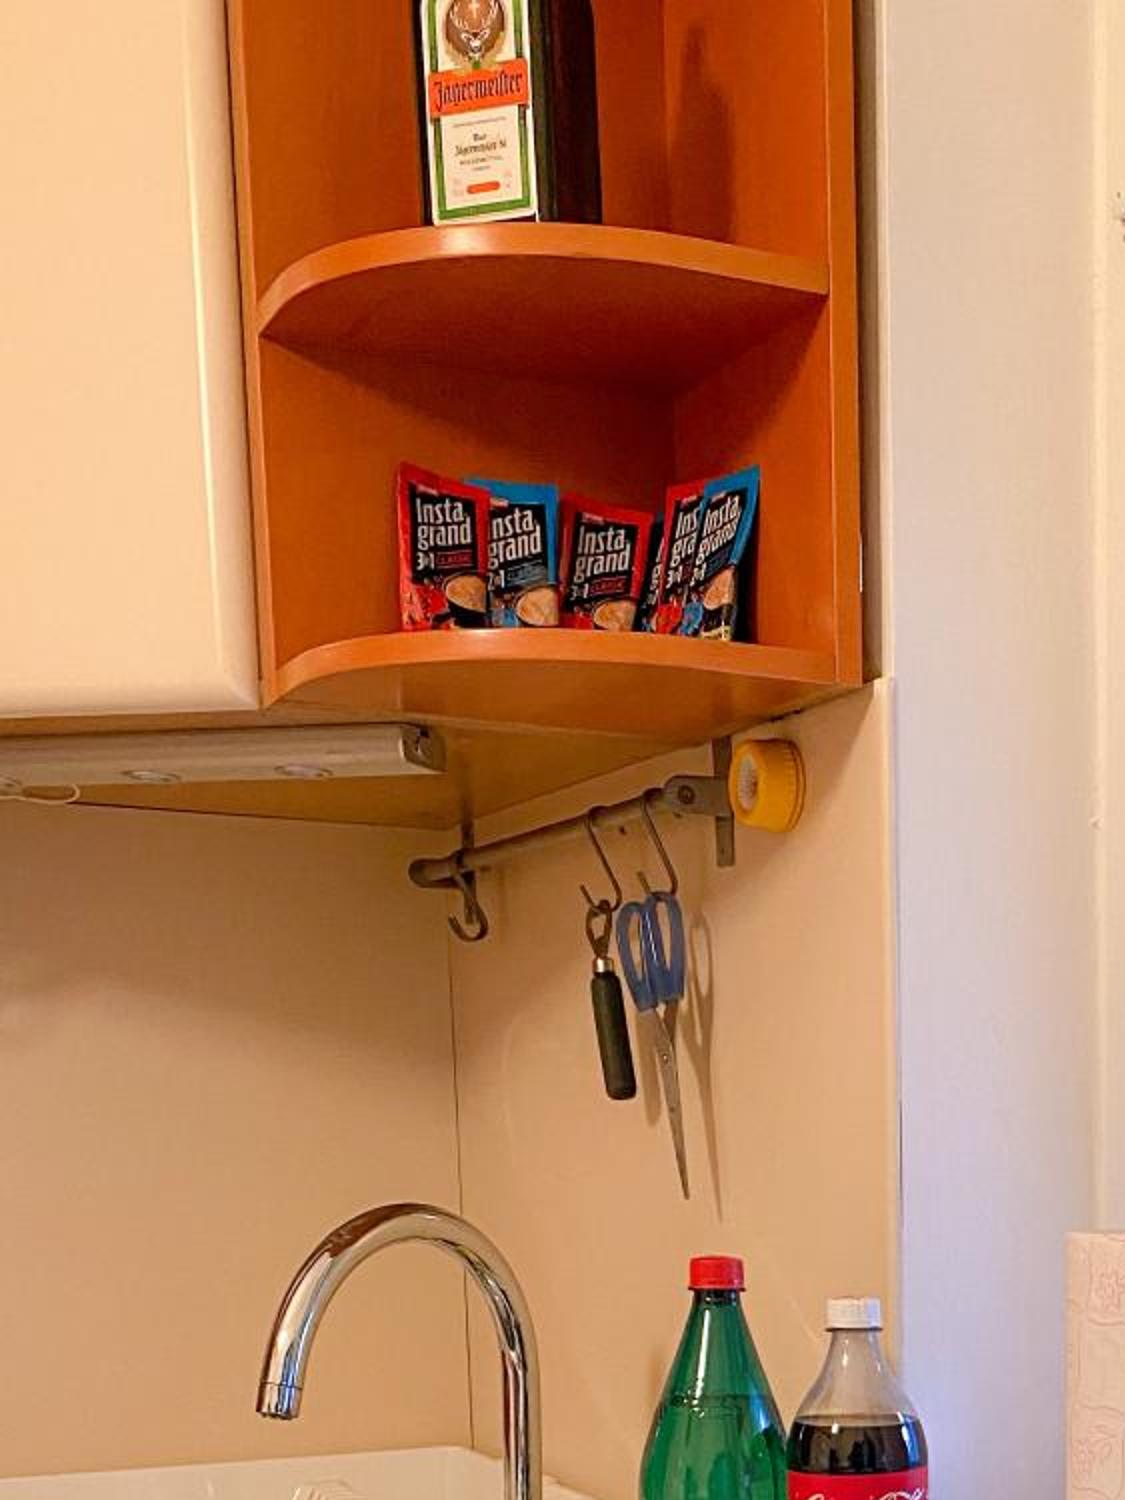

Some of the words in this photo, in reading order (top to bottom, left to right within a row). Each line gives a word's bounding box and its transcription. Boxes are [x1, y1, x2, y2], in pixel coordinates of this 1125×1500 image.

[415, 497, 464, 524] Insta
[489, 506, 535, 540] nsta
[675, 507, 700, 539] Ins
[416, 516, 473, 550] grand
[488, 523, 542, 570] grand
[577, 526, 626, 555] Insta
[670, 532, 698, 568] gra
[573, 540, 632, 583] grand
